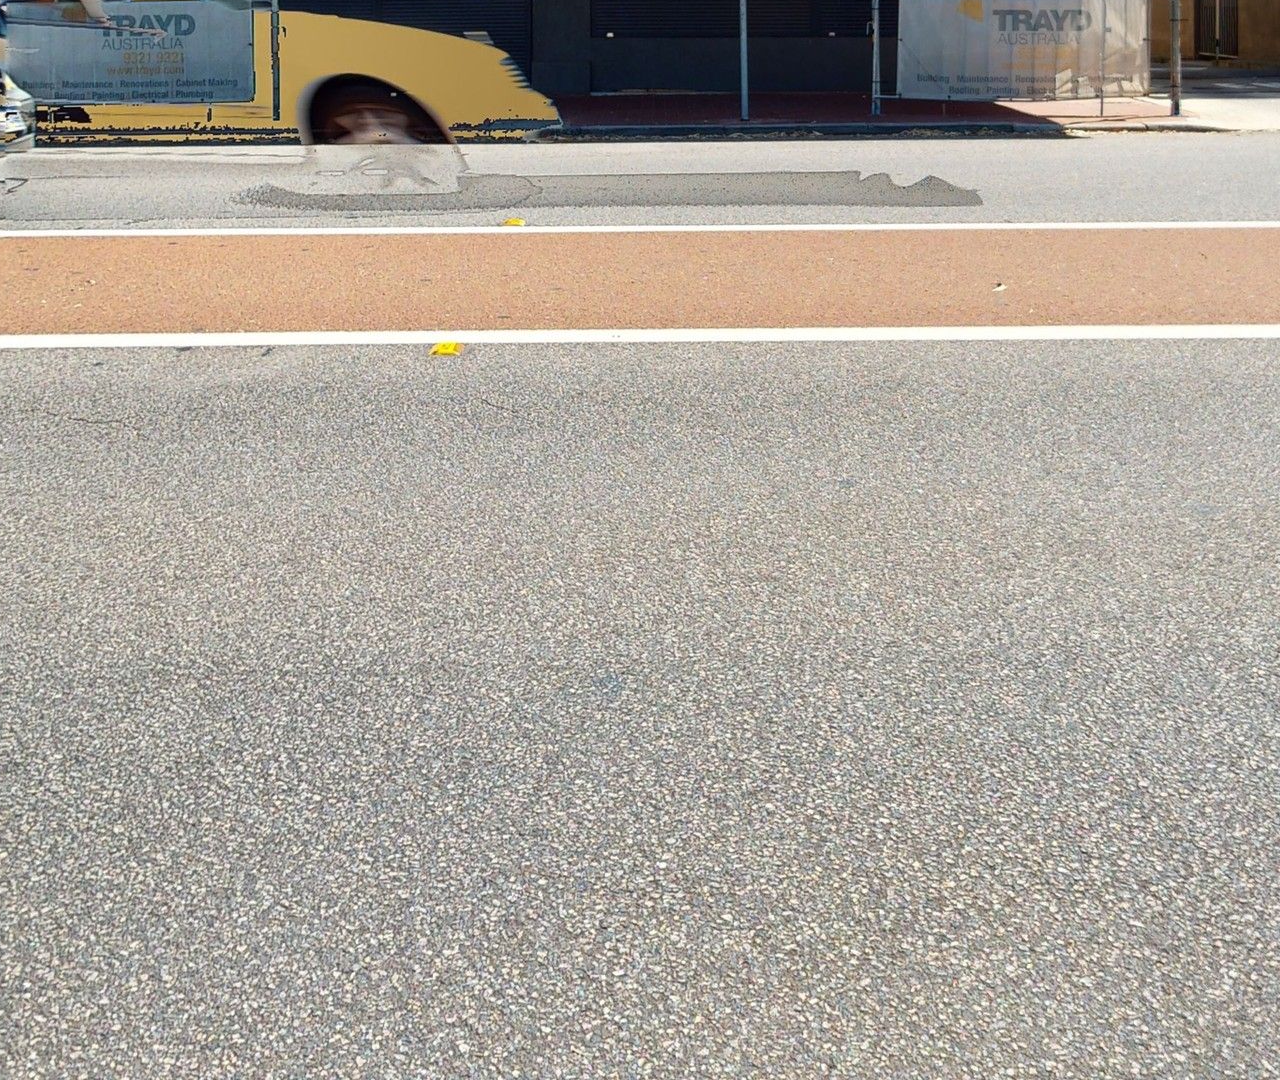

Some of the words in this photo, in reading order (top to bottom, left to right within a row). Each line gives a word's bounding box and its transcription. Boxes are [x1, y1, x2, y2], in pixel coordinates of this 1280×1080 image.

[103, 15, 195, 36] TRAYD
[993, 10, 1092, 31] TRAYD
[102, 38, 184, 50] AUSTRALIA
[999, 33, 1083, 45] AUSTRALIA
[120, 80, 169, 88] Renovations
[176, 79, 206, 87] Cabinet
[208, 79, 238, 88] Making
[917, 74, 950, 83] Building
[957, 75, 1009, 83] Maintenance
[92, 91, 124, 100] Painting
[132, 91, 169, 99] Electrical
[176, 91, 214, 99] Plumbing
[987, 87, 1020, 95] Painting
